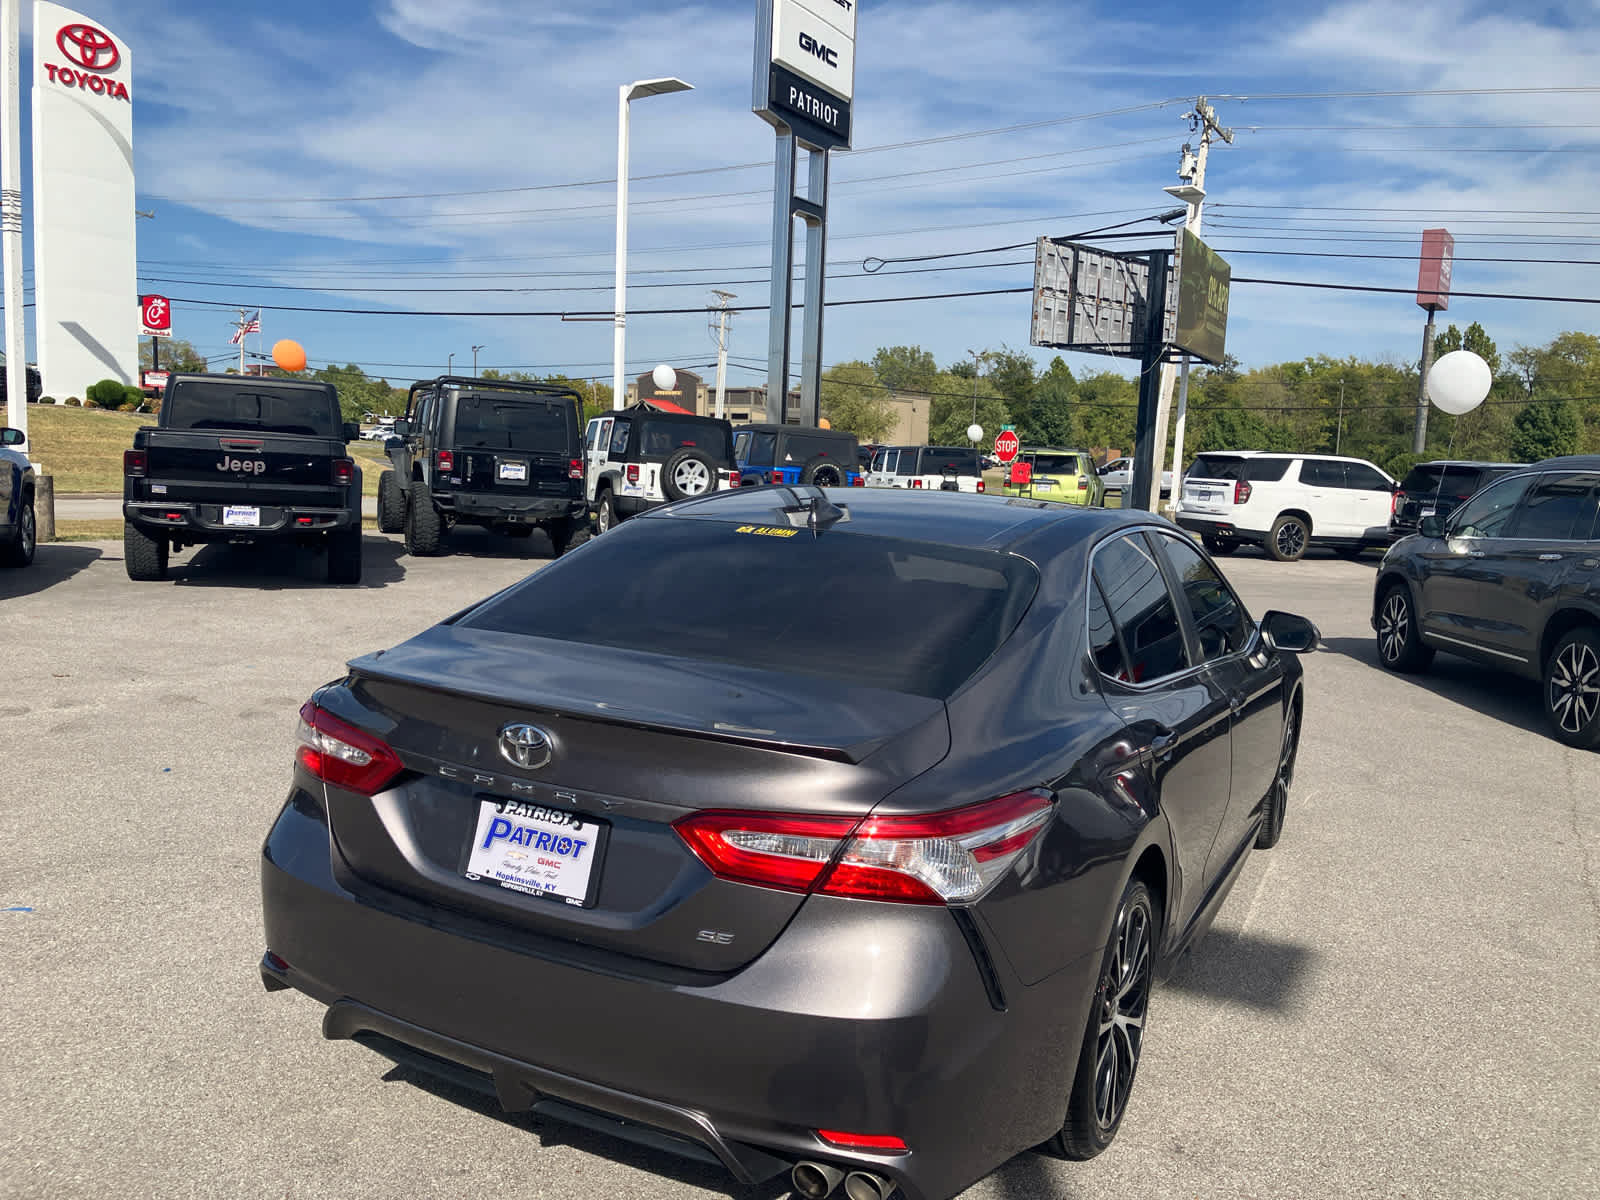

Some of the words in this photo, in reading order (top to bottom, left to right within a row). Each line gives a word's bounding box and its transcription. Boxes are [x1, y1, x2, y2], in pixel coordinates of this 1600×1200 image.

[799, 32, 838, 68] GMC
[44, 63, 130, 102] TOYOTA
[790, 86, 839, 126] PATRIOT
[996, 440, 1016, 453] STOP
[216, 456, 266, 475] Jeep
[439, 765, 625, 809] CAMRY
[505, 800, 574, 826] PATRIOT
[483, 817, 587, 858] PATRIOT
[537, 857, 562, 869] GMC
[495, 870, 542, 890] Hopkinsville,
[545, 883, 557, 892] KY
[565, 897, 584, 907] GMC
[696, 930, 736, 945] SE
